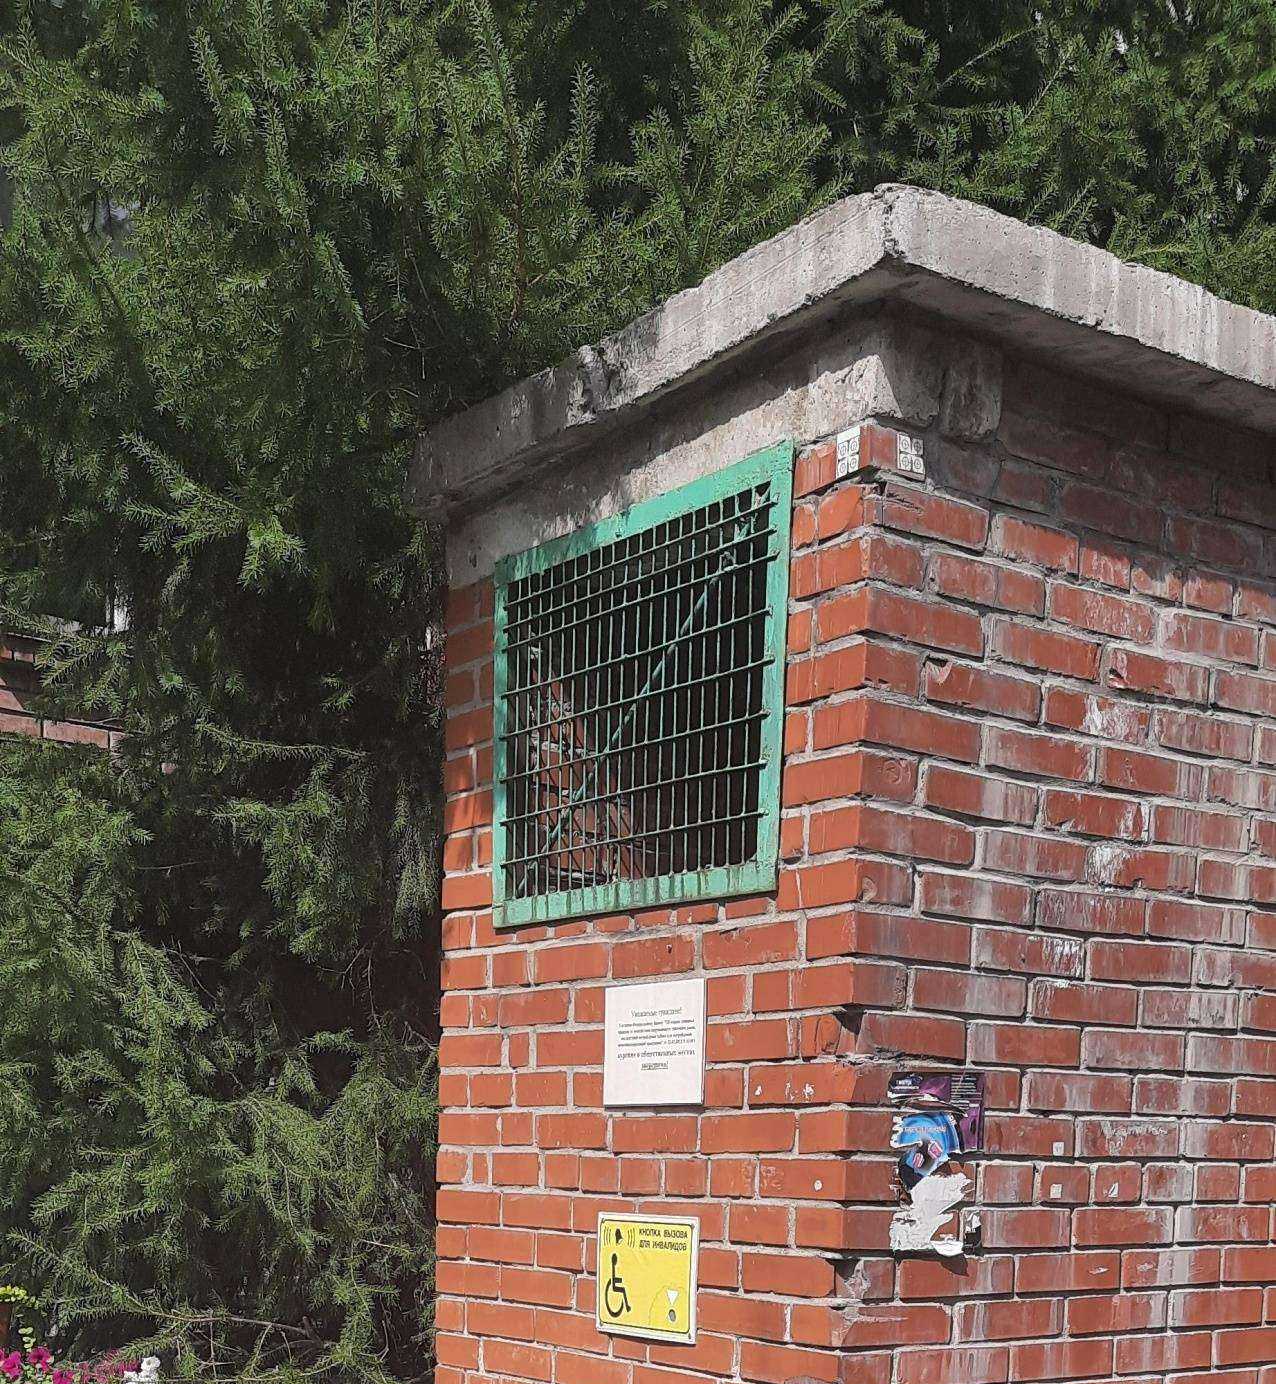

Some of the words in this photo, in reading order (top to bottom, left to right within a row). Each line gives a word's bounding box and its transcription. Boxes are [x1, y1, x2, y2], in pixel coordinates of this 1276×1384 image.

[639, 1228, 661, 1237] КНОПКА
[663, 1229, 688, 1239] ВЫЗОВА
[652, 1241, 687, 1252] ИНВАЛИДОВ
